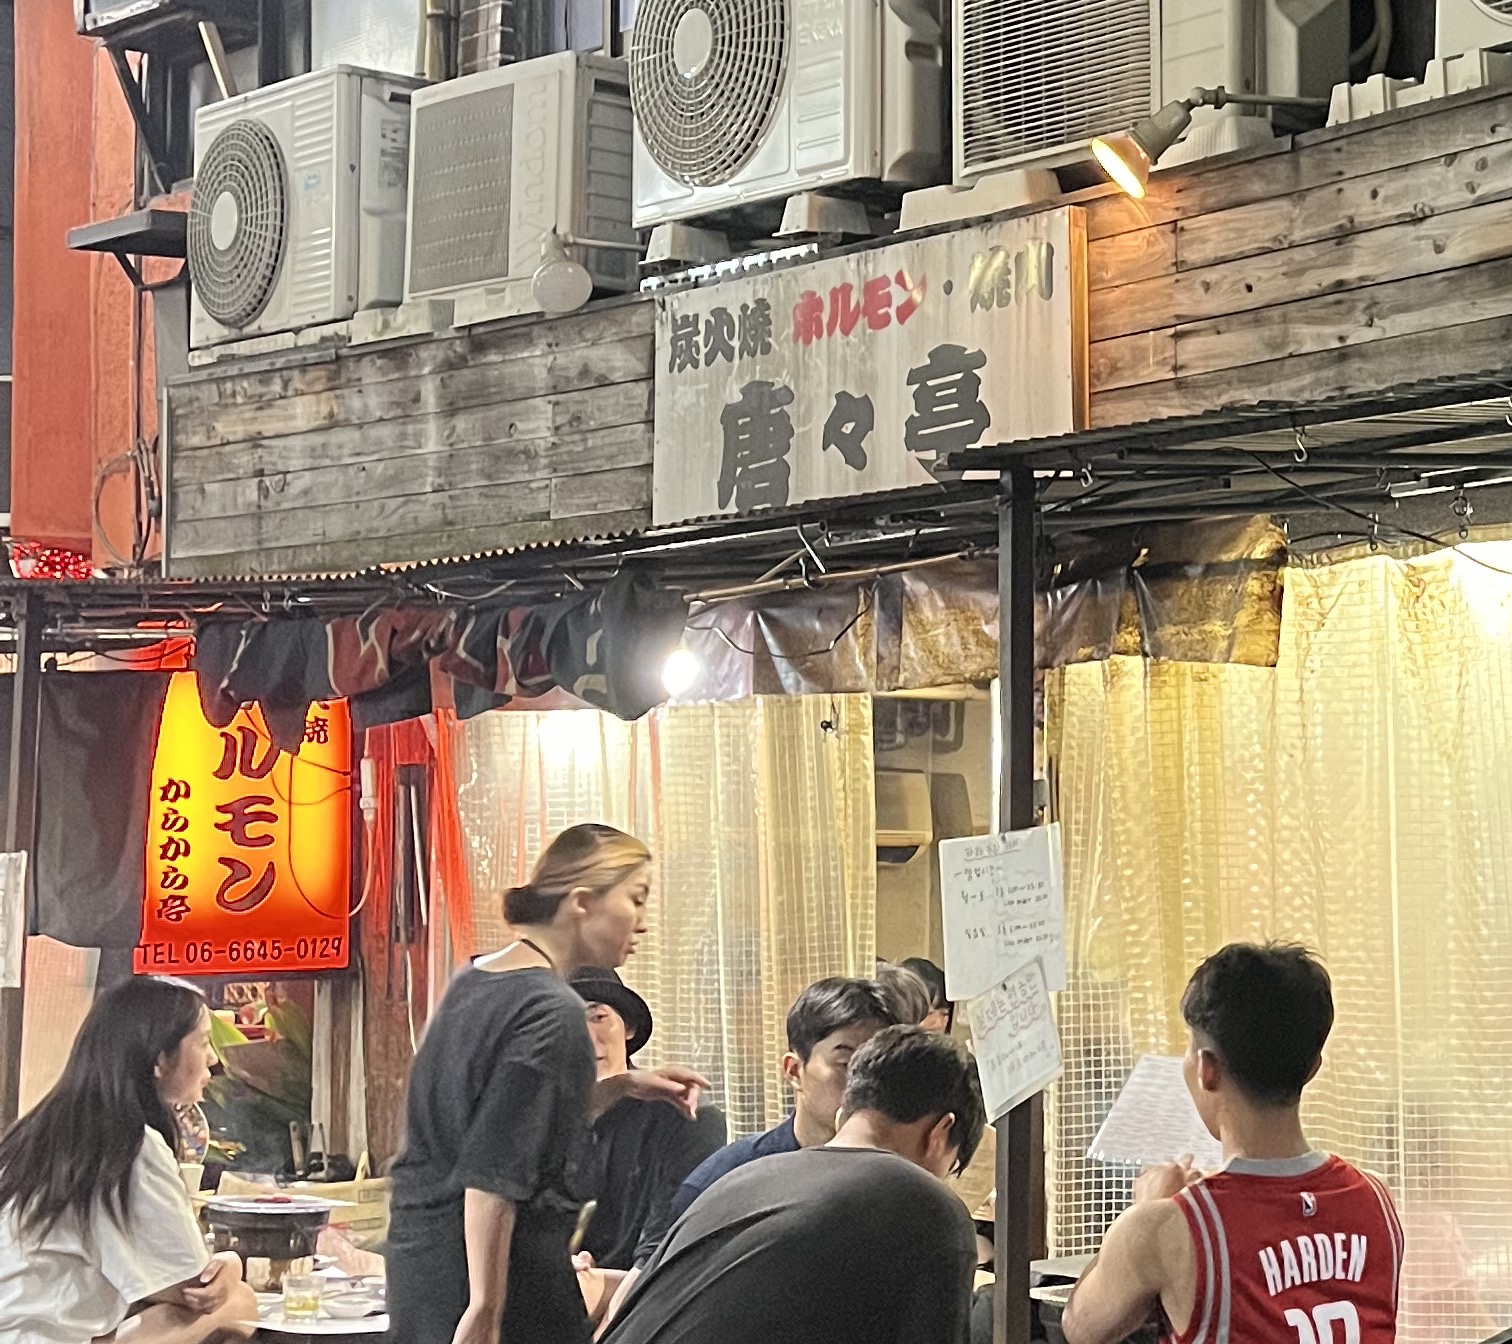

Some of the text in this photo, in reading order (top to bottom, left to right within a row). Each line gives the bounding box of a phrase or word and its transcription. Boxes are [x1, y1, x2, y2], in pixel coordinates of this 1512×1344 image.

[669, 297, 773, 373] 炭火焼
[156, 779, 192, 922] からから亭
[212, 725, 281, 913] ルモン
[141, 936, 343, 965] TEL 06-6645-0129
[1258, 1232, 1368, 1297] HARDEN
